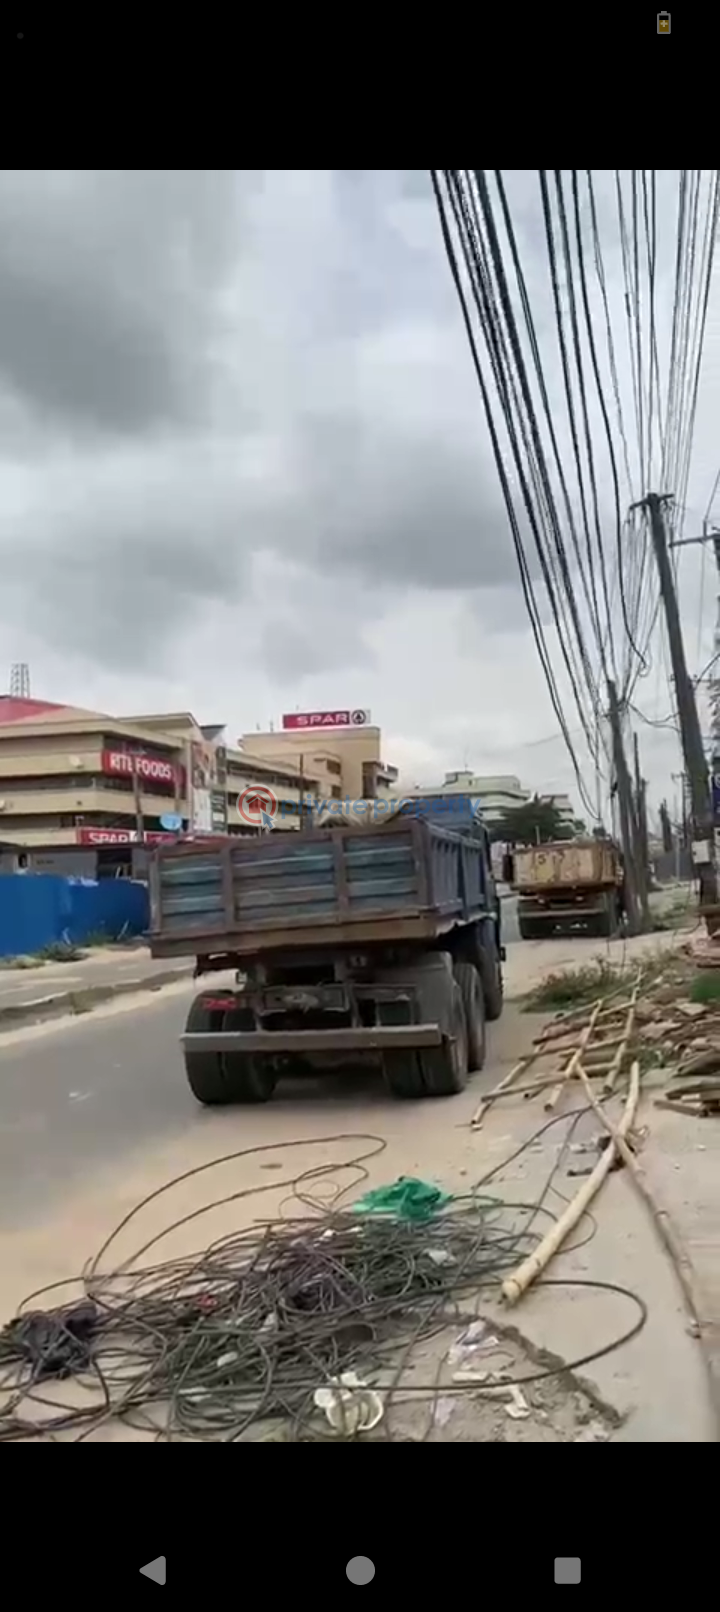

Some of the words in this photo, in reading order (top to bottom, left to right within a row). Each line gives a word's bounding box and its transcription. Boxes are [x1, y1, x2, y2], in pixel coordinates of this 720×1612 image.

[296, 712, 348, 725] SPAR
[109, 752, 133, 772] RITE
[135, 756, 172, 780] FOODS
[88, 832, 129, 845] SPAR
